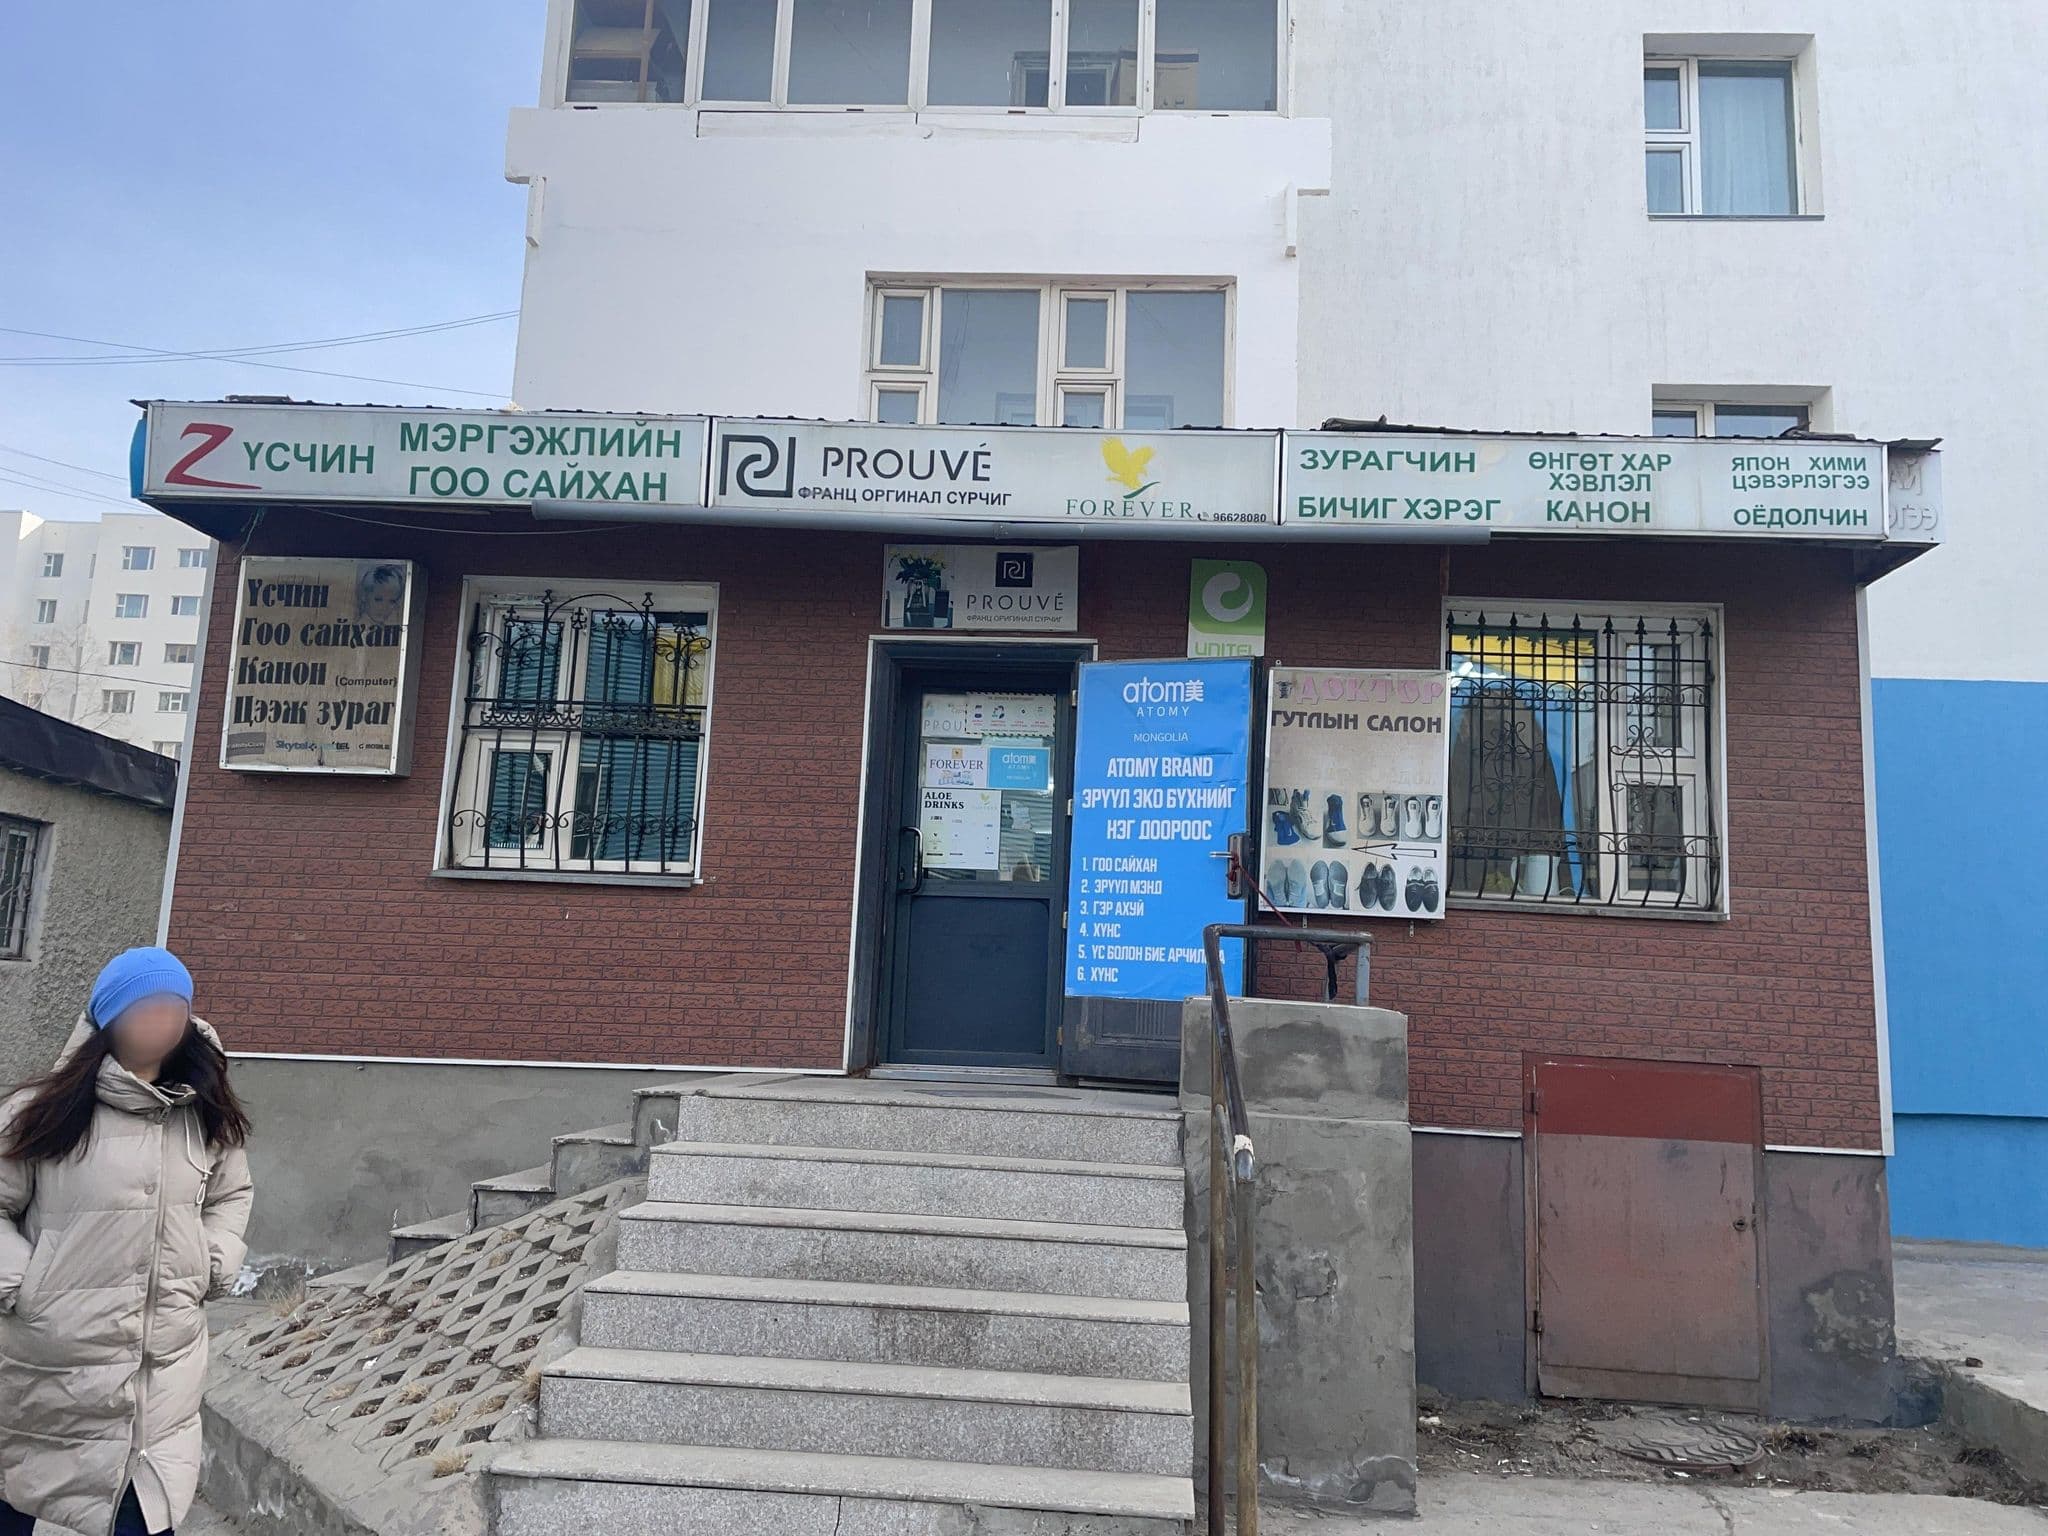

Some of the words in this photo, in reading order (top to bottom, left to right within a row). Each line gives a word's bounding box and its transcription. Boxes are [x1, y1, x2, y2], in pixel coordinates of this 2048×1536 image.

[400, 421, 681, 459] МЭРГЭЖЛИЙН
[243, 440, 374, 474] ҮСЧИН
[823, 444, 991, 482] PROUVÉ
[1300, 449, 1476, 472] ЗУРАГЧИН
[1529, 452, 1613, 471] ӨНГӨТ
[1621, 454, 1672, 472] ХАР
[1732, 457, 1790, 471] ЯПОН
[1809, 457, 1867, 471] ХИМИ
[409, 466, 489, 497] ГОО
[503, 463, 667, 501] САЙХАН
[1549, 472, 1651, 492] ХЭВЛЭЛ
[1733, 475, 1870, 491] ЦЭВЭРЛЭГЭЭ
[798, 487, 856, 503] ФРАНЦ
[862, 489, 941, 504] ОРГИНАЛ
[946, 491, 1011, 506] СҮРЧИГ
[1066, 499, 1193, 518] FOREVER
[1213, 513, 1267, 523] 96628080
[1298, 496, 1397, 518] БИЧИГ
[1403, 498, 1501, 520] ХЭРЭГ
[1547, 500, 1650, 523] КАНОН
[1734, 504, 1868, 528] ОЁДОЛЧИН
[248, 579, 330, 608] Үсчин
[966, 592, 1063, 610] PROUVÉ
[242, 618, 291, 646] Гоо
[238, 657, 327, 685] Канон
[1297, 677, 1444, 705] ДОКТОР
[233, 696, 308, 727] Цээж
[317, 700, 395, 730] зураг
[1137, 706, 1190, 717] ATOMY
[1271, 711, 1358, 730] ГУТЛЫН
[1367, 715, 1442, 733] САЛОН
[1133, 733, 1189, 742] MONGOLIA
[930, 759, 983, 770] FOREVER
[1107, 757, 1158, 777] ATOMY
[1162, 757, 1213, 777] BRAND
[924, 792, 952, 800] ALOE
[924, 801, 964, 809] DRINKS
[1082, 788, 1129, 808] ЭРҮҮЛ
[1133, 788, 1163, 808] ЭКО
[1107, 819, 1136, 840] НЭГ
[1139, 819, 1212, 841] ДООРООС
[1082, 857, 1089, 871] 1.
[1092, 857, 1112, 871] ГОО
[1114, 855, 1157, 872] САЙХАН
[1081, 879, 1090, 893] 2.
[1130, 880, 1162, 894] МЭНД
[1080, 900, 1089, 915] 3.
[1093, 900, 1113, 915] ГЭР
[1115, 899, 1144, 916] АХУЙ
[1079, 922, 1089, 937] 4.
[1078, 944, 1087, 959] 5.
[1107, 945, 1143, 961] БОЛОН
[1144, 946, 1165, 962] БИЕ
[1077, 967, 1086, 982] 6.
